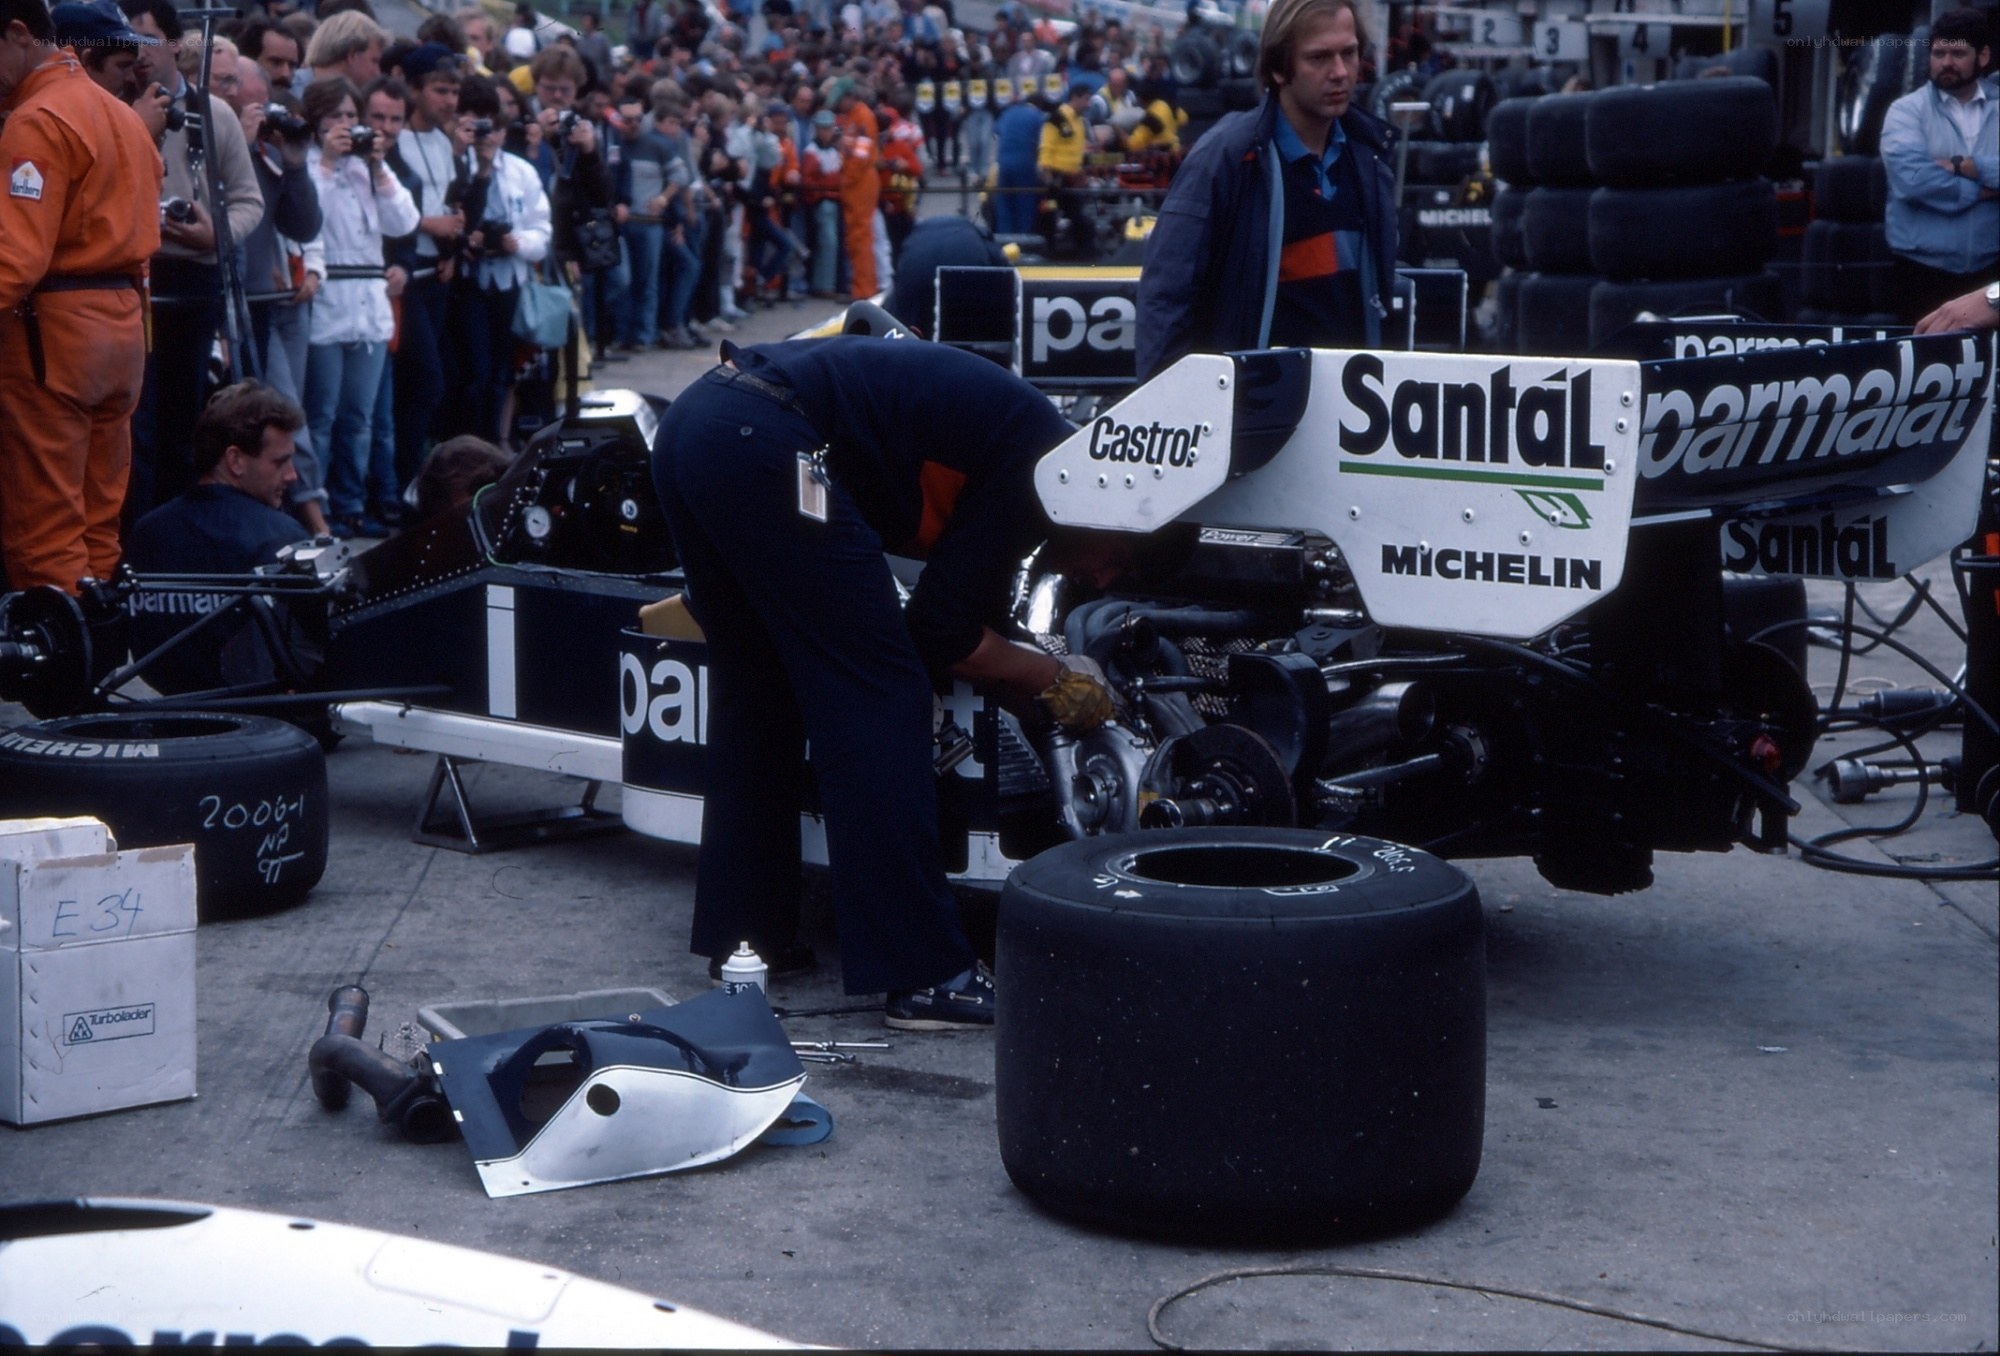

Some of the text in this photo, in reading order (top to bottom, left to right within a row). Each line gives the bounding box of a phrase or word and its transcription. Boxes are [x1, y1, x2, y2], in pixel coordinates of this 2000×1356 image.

[1483, 18, 1497, 44] 2
[1773, 0, 1792, 35] 5
[1545, 28, 1560, 55] 3
[1632, 24, 1648, 52] 4
[1640, 338, 1984, 479] parmalat
[1089, 415, 1202, 468] Castrol
[1381, 543, 1602, 590] MICHELIN
[0, 732, 159, 758] MICHELI
[90, 887, 144, 940] 34
[89, 1008, 151, 1025] Turbolader
